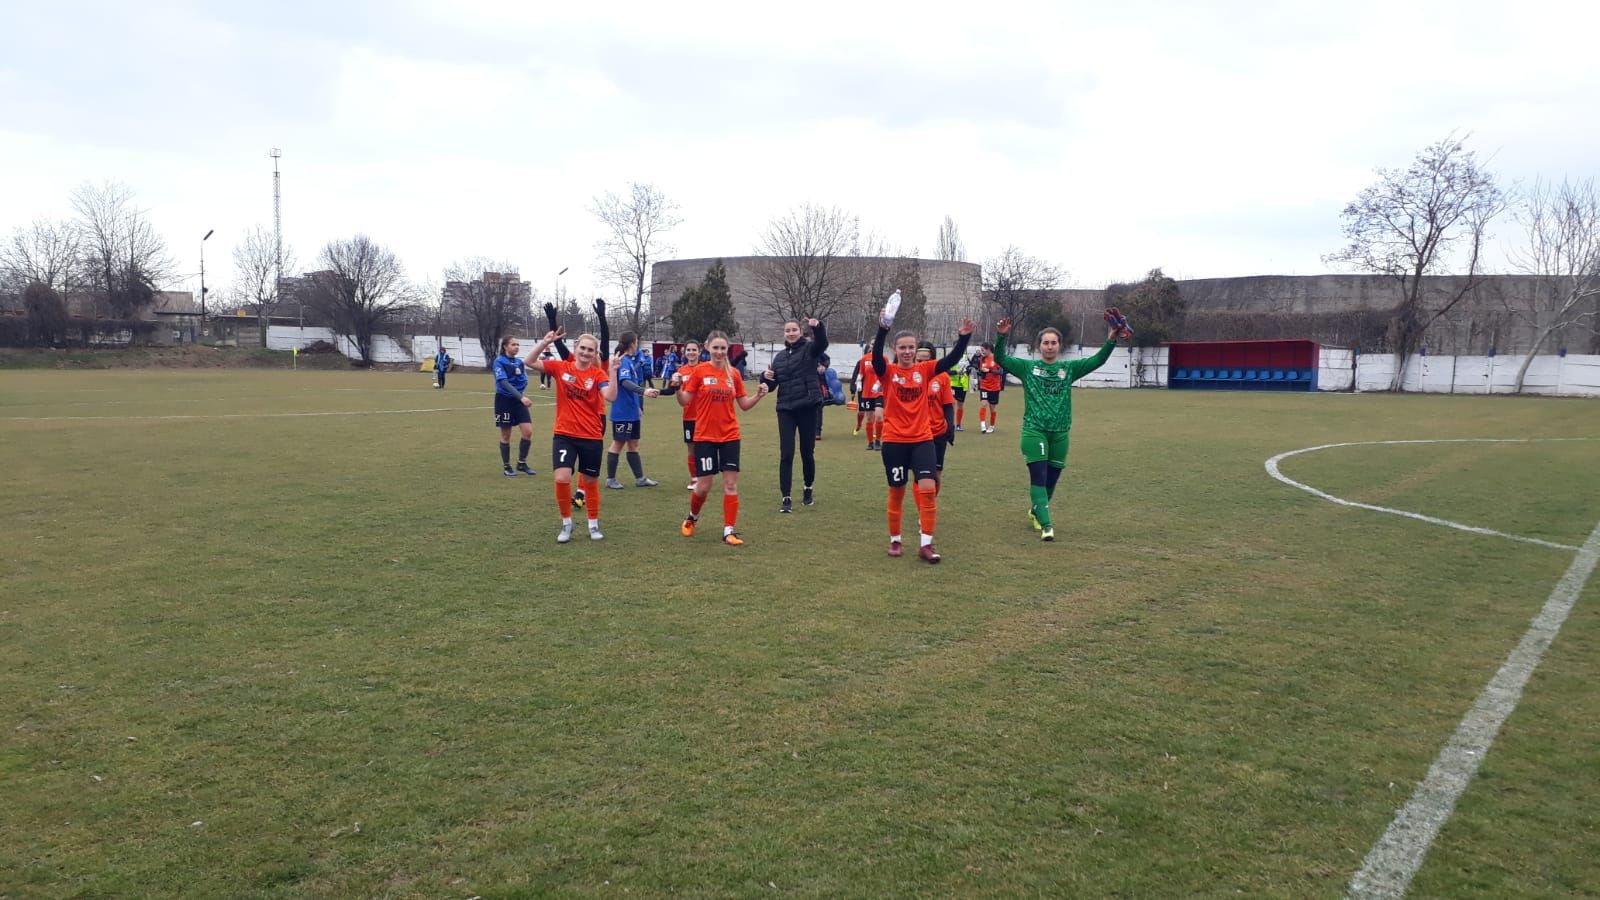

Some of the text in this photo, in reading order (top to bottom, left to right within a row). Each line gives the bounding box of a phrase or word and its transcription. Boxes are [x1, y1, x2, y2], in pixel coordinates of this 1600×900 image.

[559, 449, 568, 463] 7
[1039, 442, 1045, 456] 1
[700, 456, 713, 471] 10
[891, 465, 904, 482] 21
